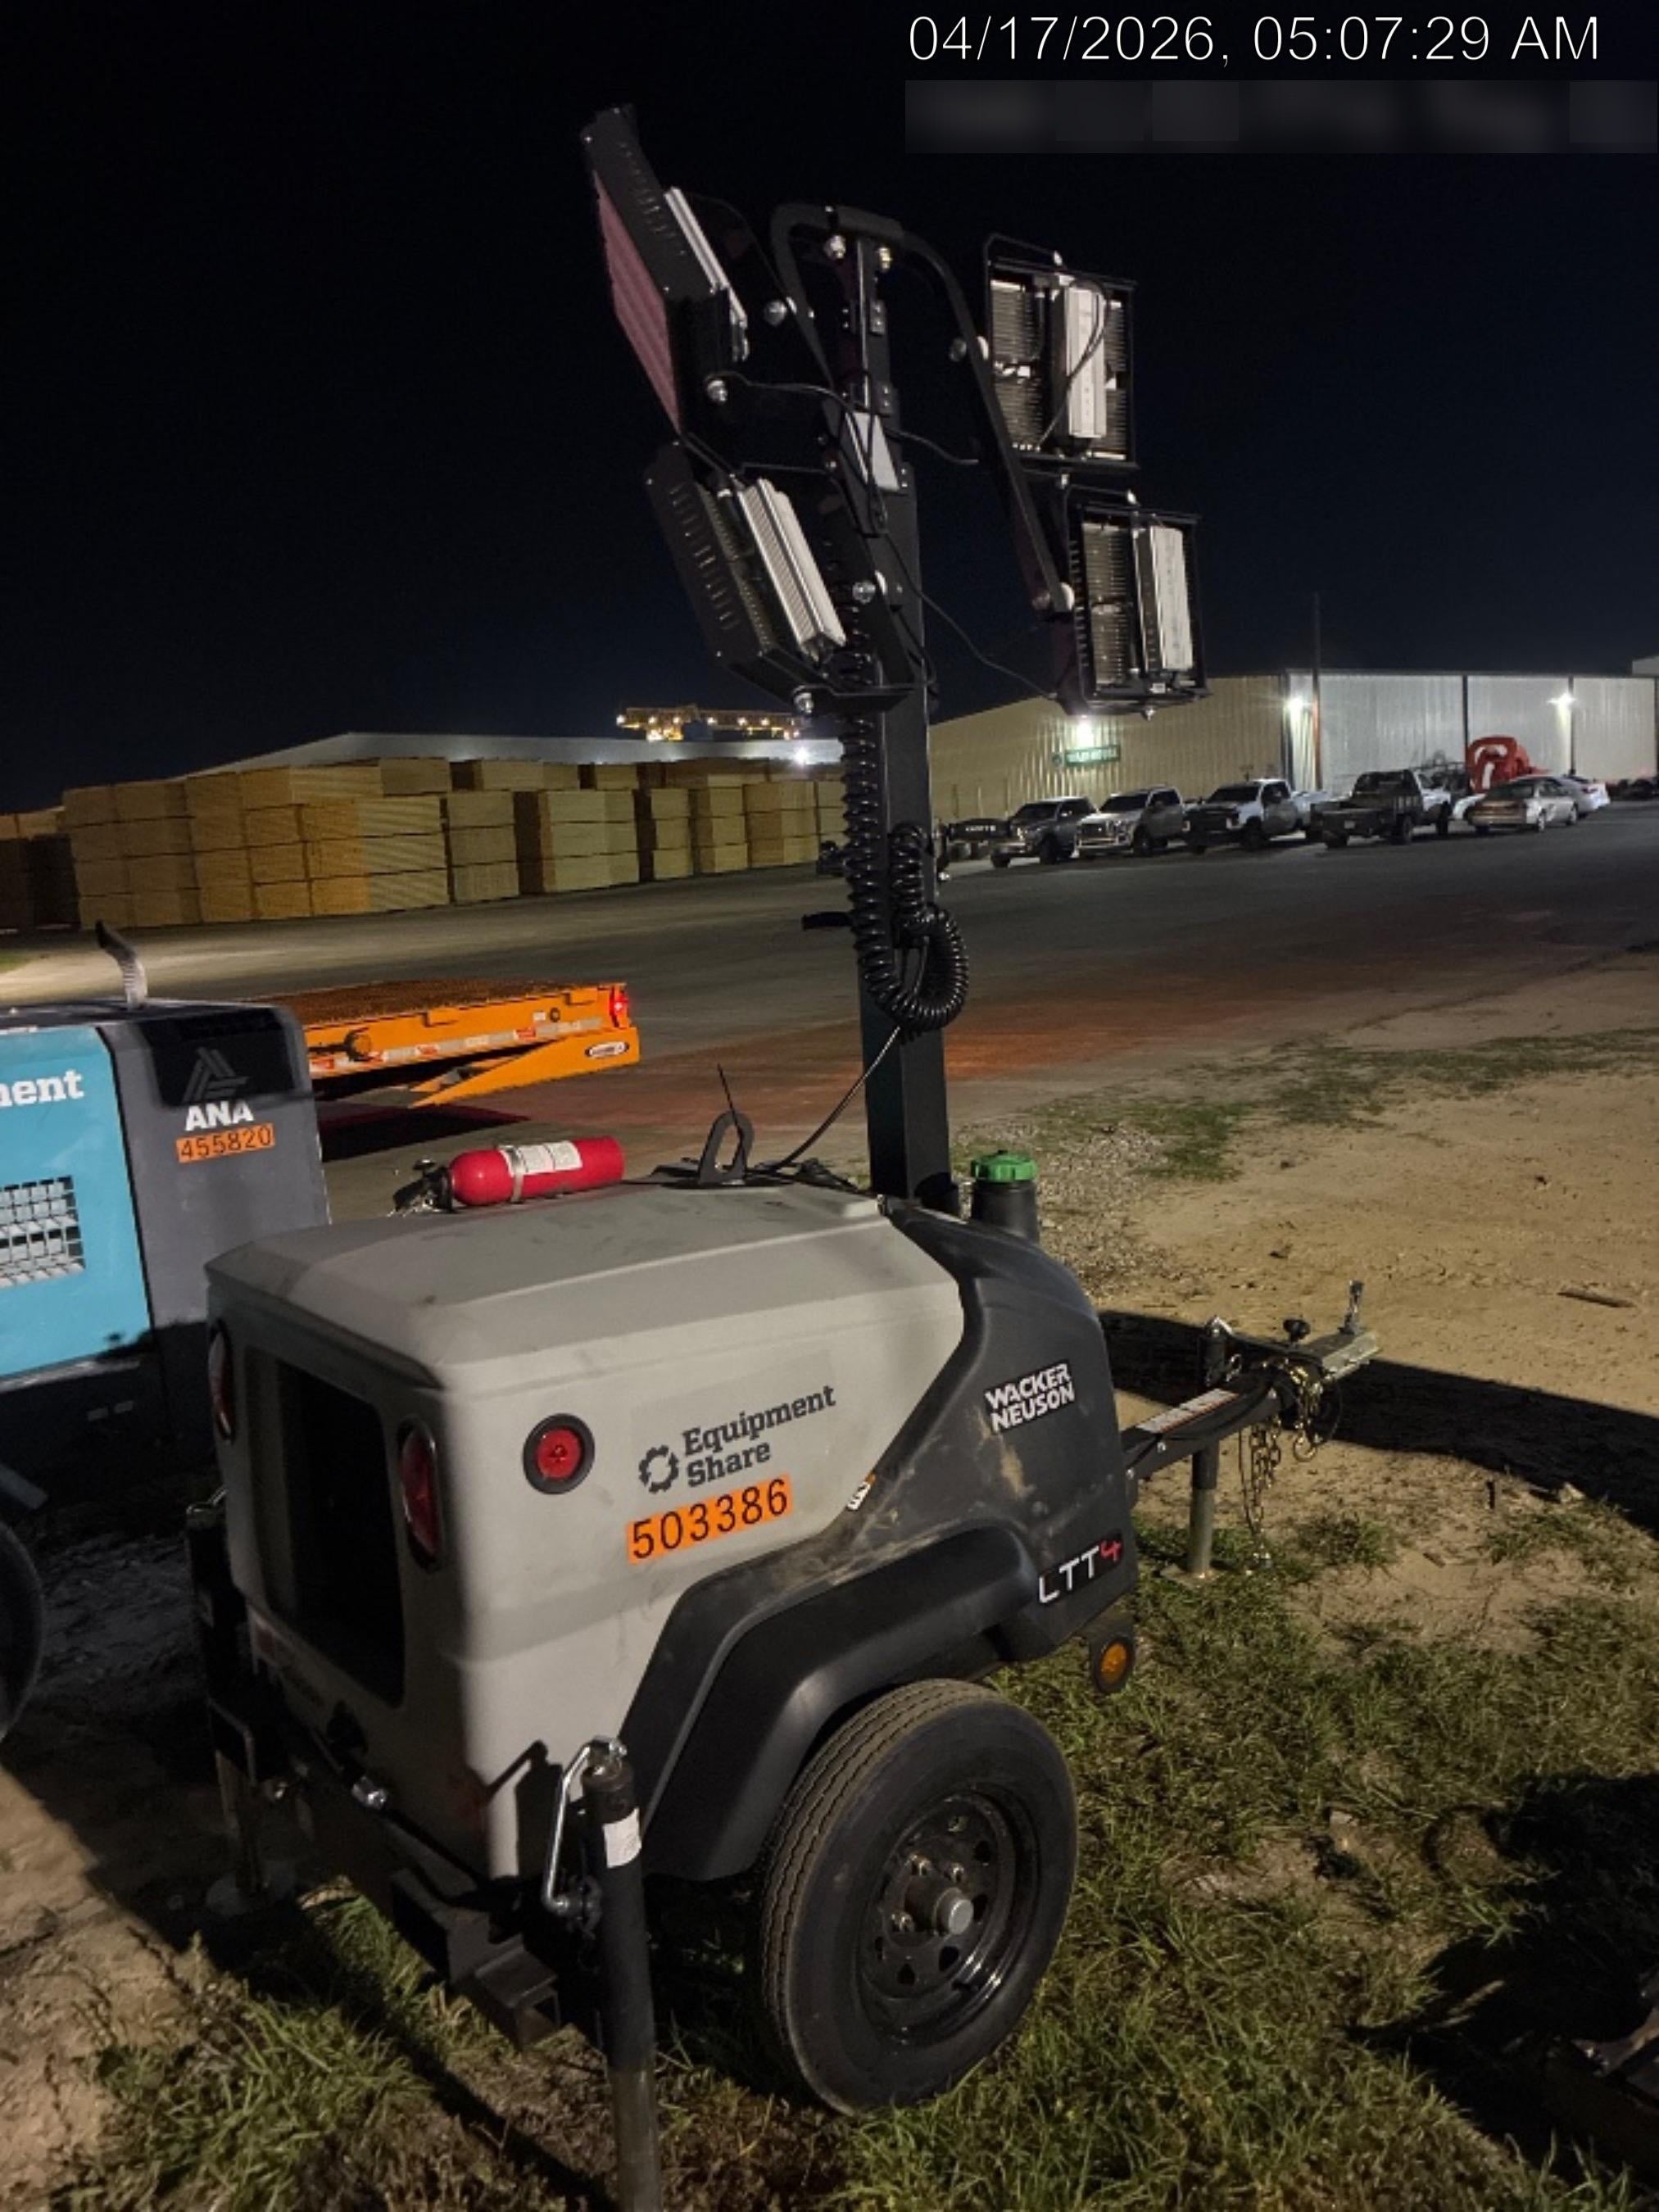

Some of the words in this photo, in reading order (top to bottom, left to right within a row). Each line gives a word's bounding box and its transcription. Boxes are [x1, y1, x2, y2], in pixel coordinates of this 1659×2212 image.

[185, 1099, 254, 1131] ANA
[180, 1126, 272, 1159] 455820
[985, 1362, 1071, 1410] WACKER
[990, 1380, 1076, 1432] NEUSON
[682, 1385, 836, 1456] Equipment
[686, 1441, 772, 1488] Share
[632, 1477, 788, 1560] 503386
[1039, 1540, 1122, 1603] LTT4
